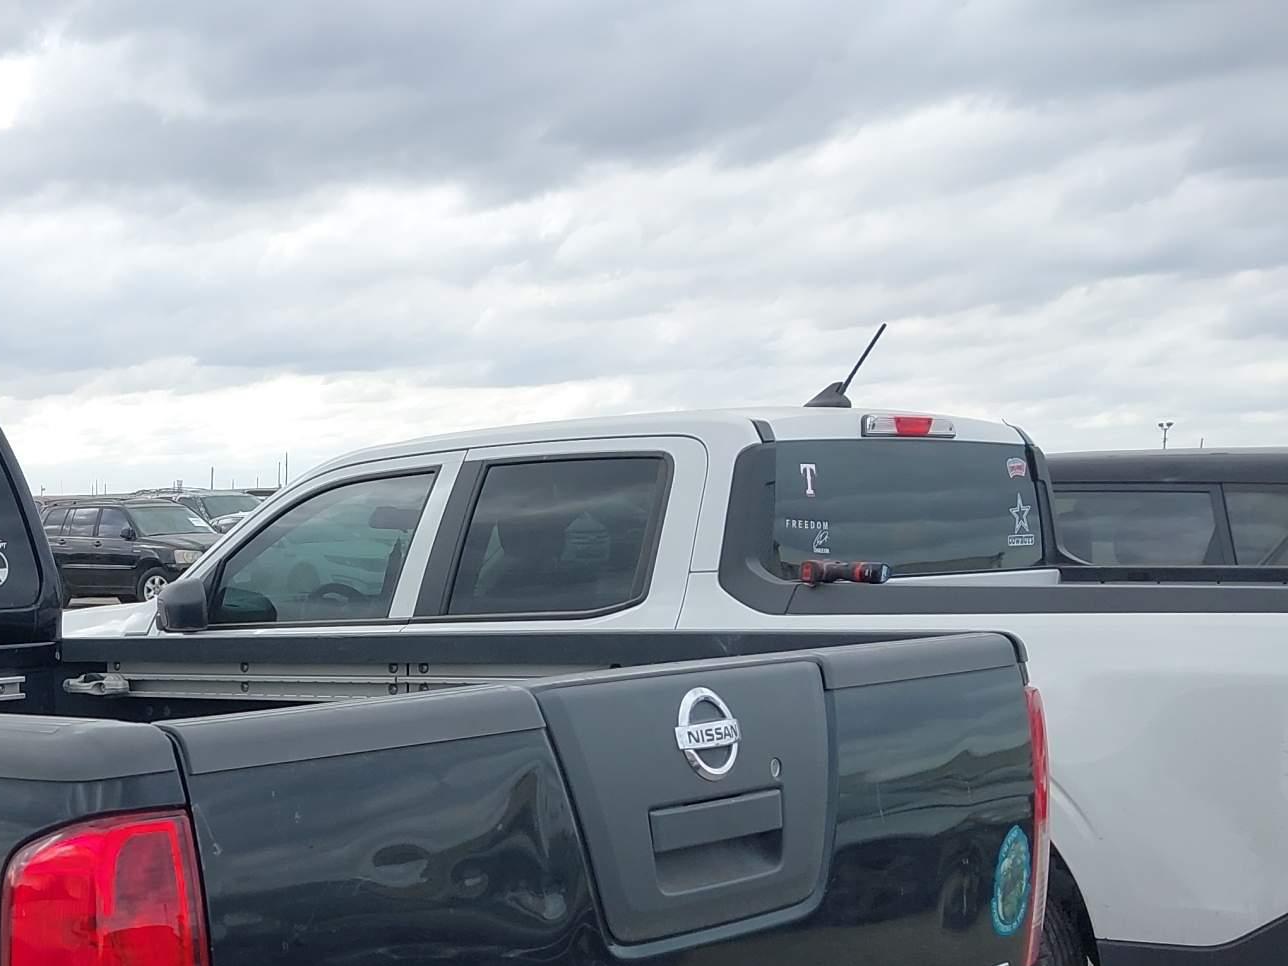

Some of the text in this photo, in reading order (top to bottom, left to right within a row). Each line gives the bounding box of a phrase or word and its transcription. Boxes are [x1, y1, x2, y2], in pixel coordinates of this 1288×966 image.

[800, 463, 817, 497] T
[786, 519, 829, 530] FREEDOM
[687, 724, 738, 745] NISSAN
